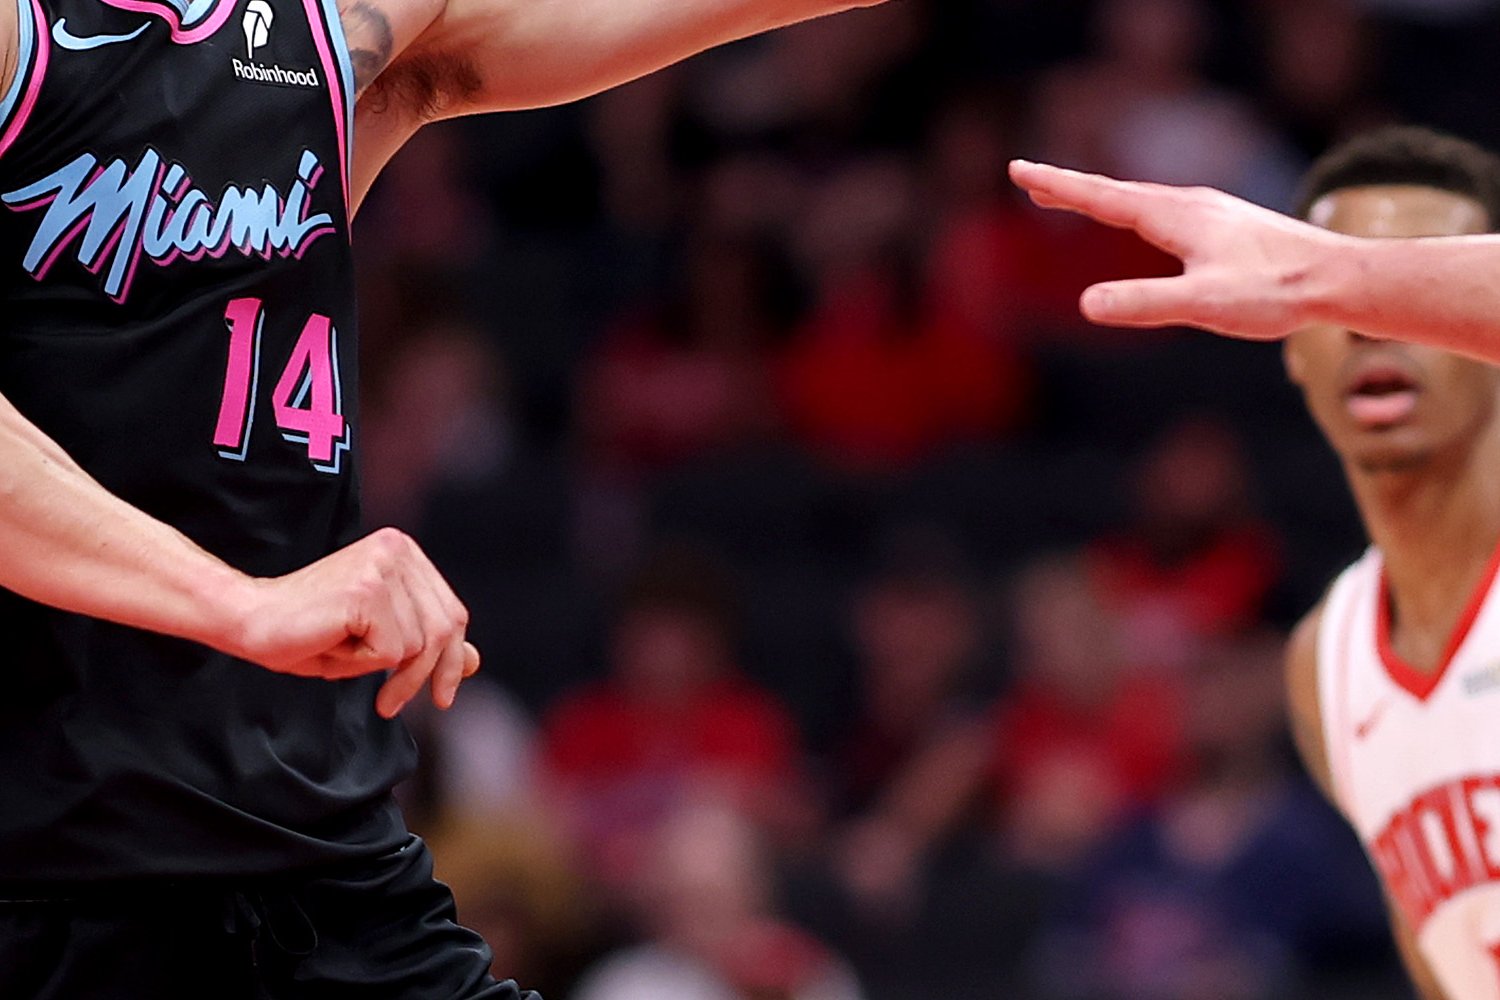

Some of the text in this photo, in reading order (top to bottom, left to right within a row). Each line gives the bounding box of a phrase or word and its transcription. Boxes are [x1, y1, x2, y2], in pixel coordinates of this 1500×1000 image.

[232, 58, 318, 87] Robinhood
[1, 148, 336, 304] Miami
[213, 297, 350, 474] 14
